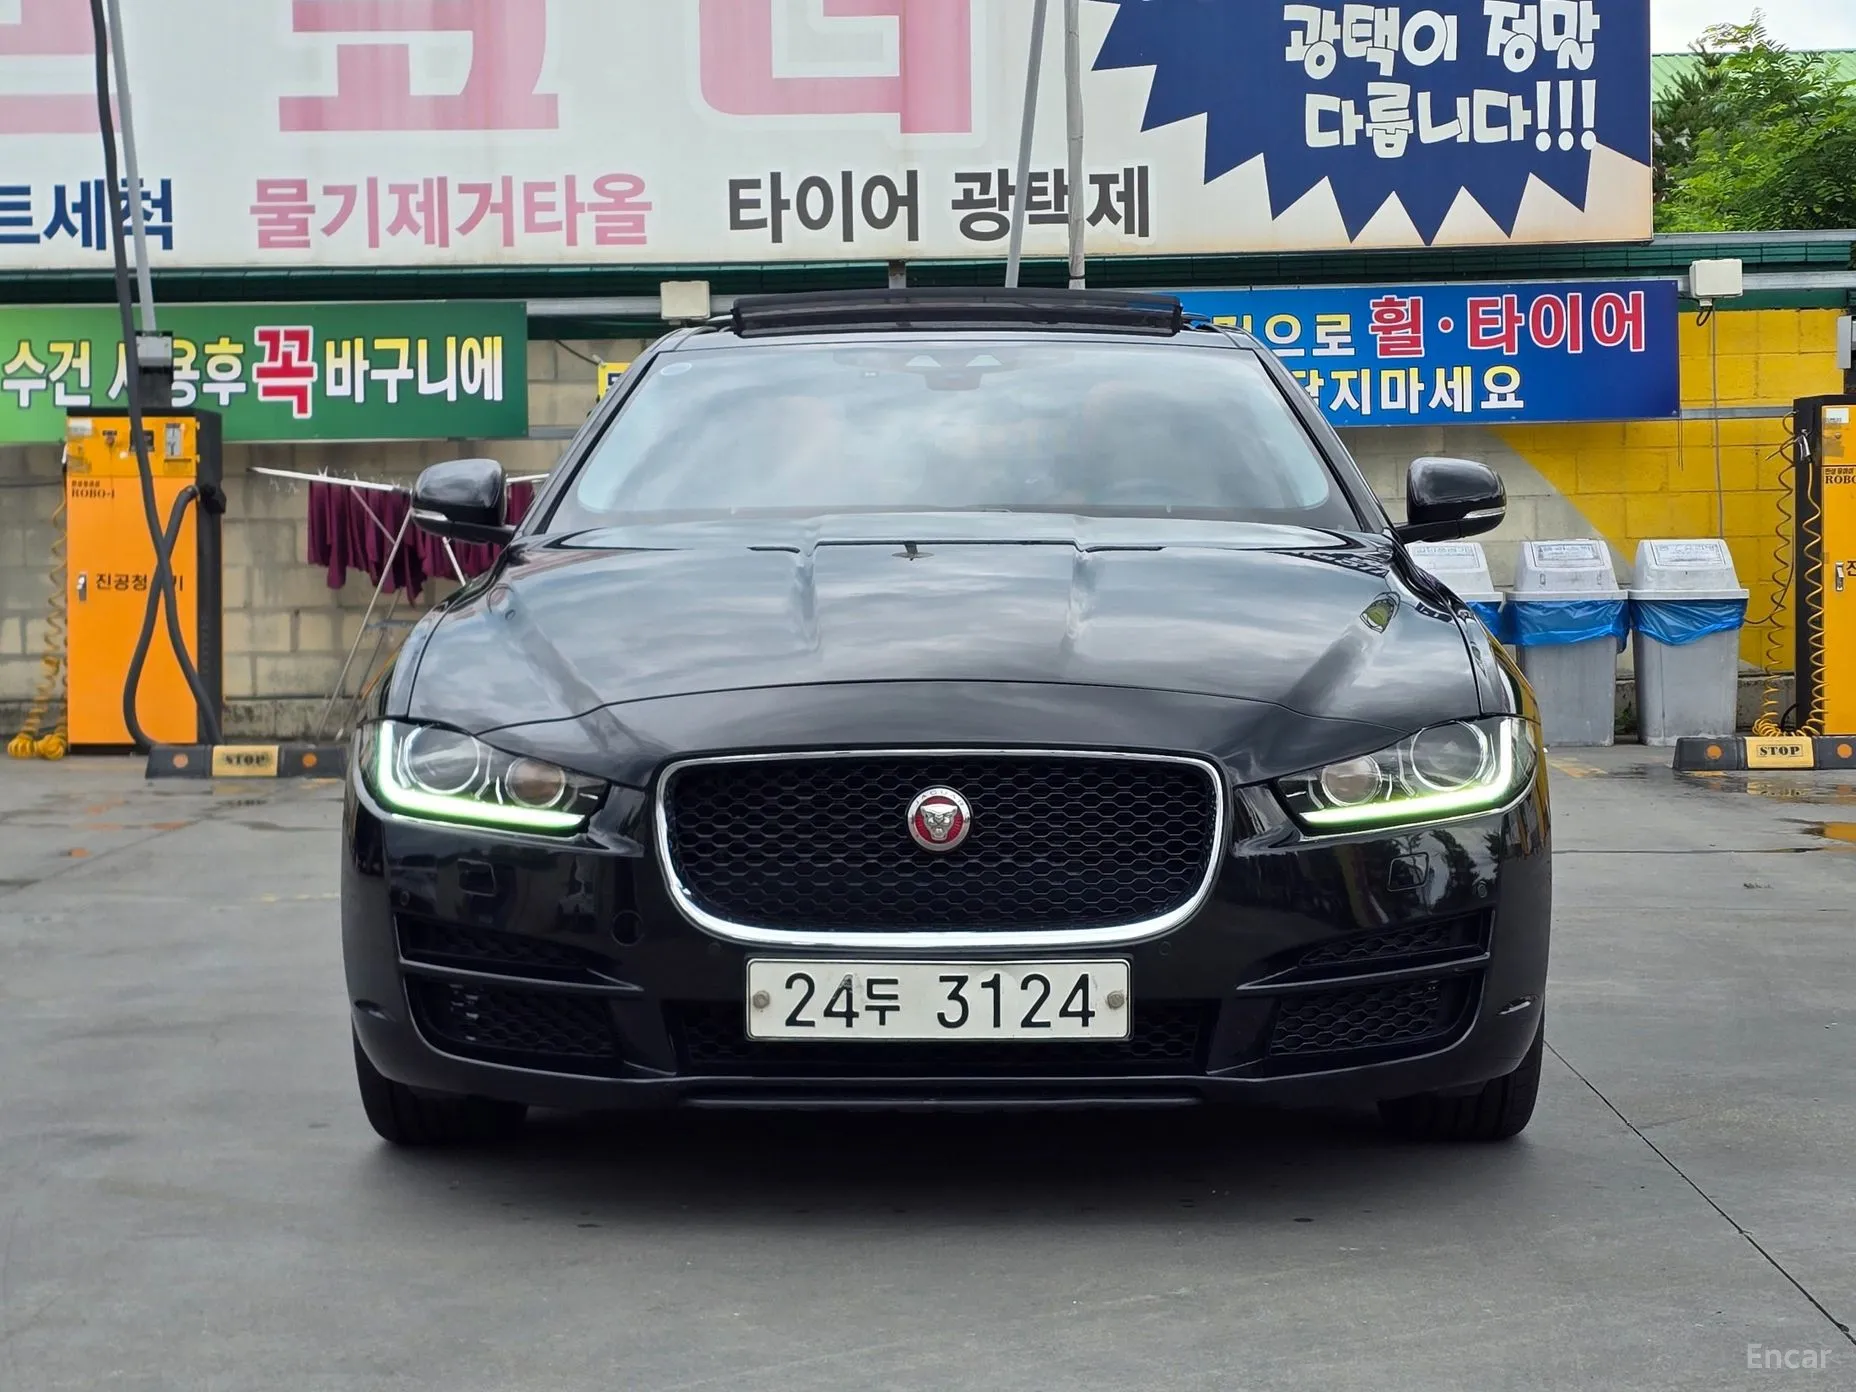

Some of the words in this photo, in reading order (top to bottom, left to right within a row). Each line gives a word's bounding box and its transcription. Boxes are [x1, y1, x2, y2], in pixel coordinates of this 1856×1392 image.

[1284, 4, 1457, 80] 광택이
[1483, 0, 1600, 73] 정말
[250, 173, 652, 249] 물기제거타올
[728, 170, 919, 243] 타이어
[3, 340, 91, 407] 수건
[325, 336, 503, 403] 바구니에
[96, 573, 184, 592] 진공청기
[225, 754, 266, 766] STOP
[1760, 746, 1800, 756] STOP
[785, 973, 900, 1028] 24두
[937, 973, 1095, 1028] 3124
